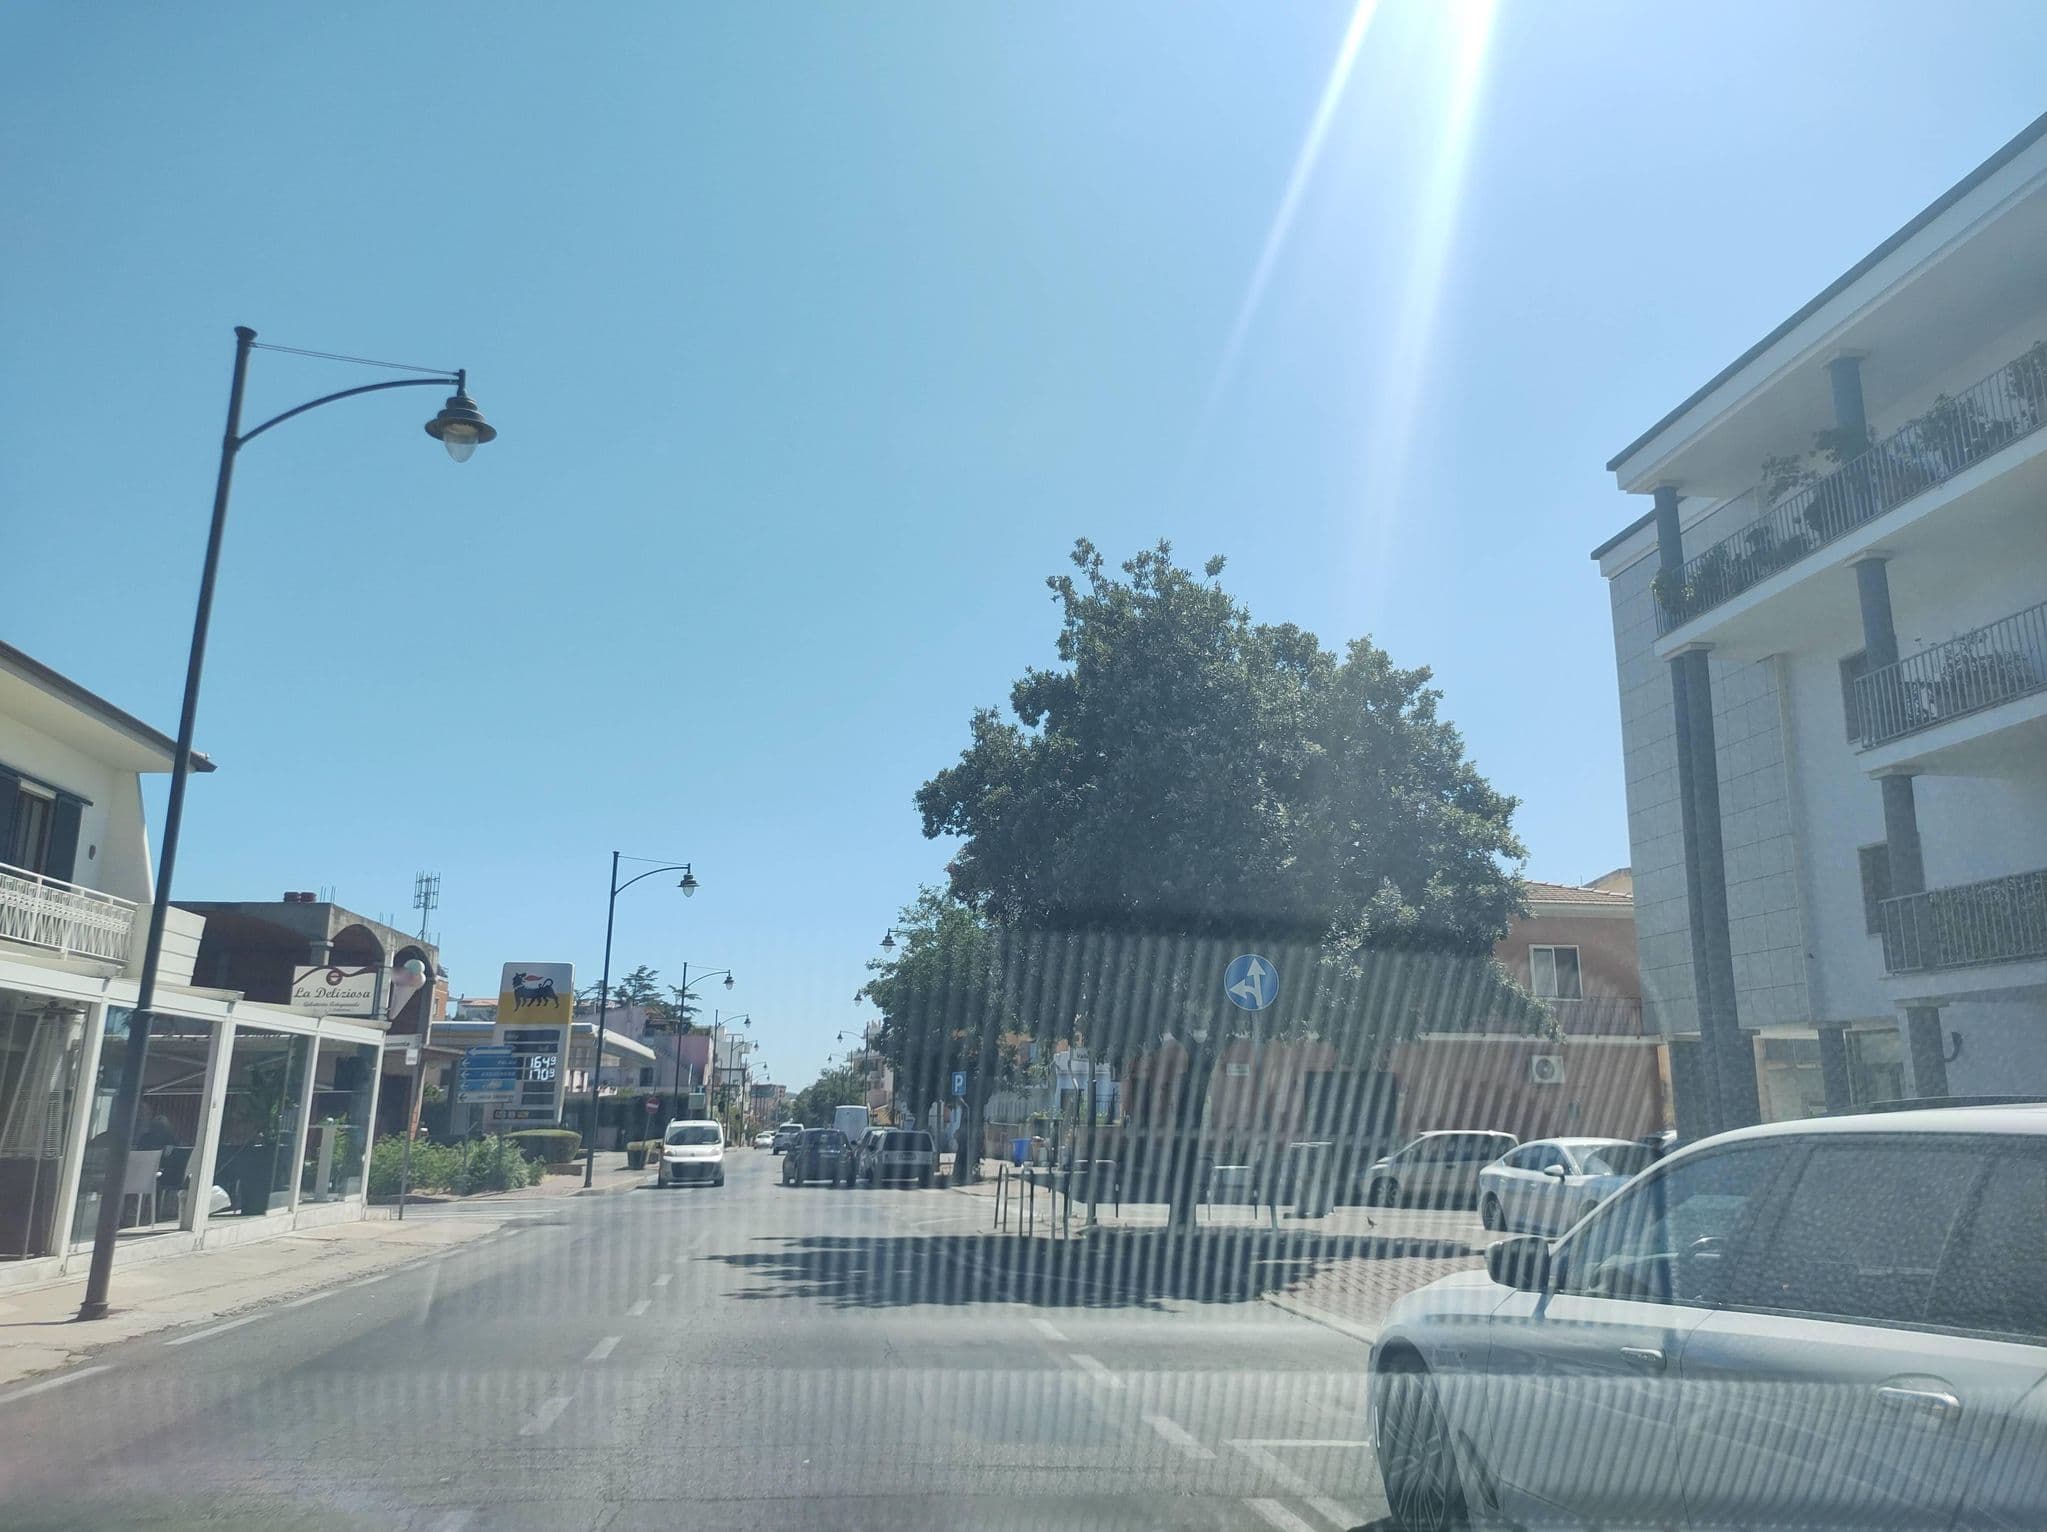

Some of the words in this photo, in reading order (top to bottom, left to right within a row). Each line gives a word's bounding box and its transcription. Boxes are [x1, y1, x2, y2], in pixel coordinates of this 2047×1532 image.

[294, 987, 311, 998] La
[314, 986, 371, 998] Deliziosa
[955, 1074, 964, 1092] P
